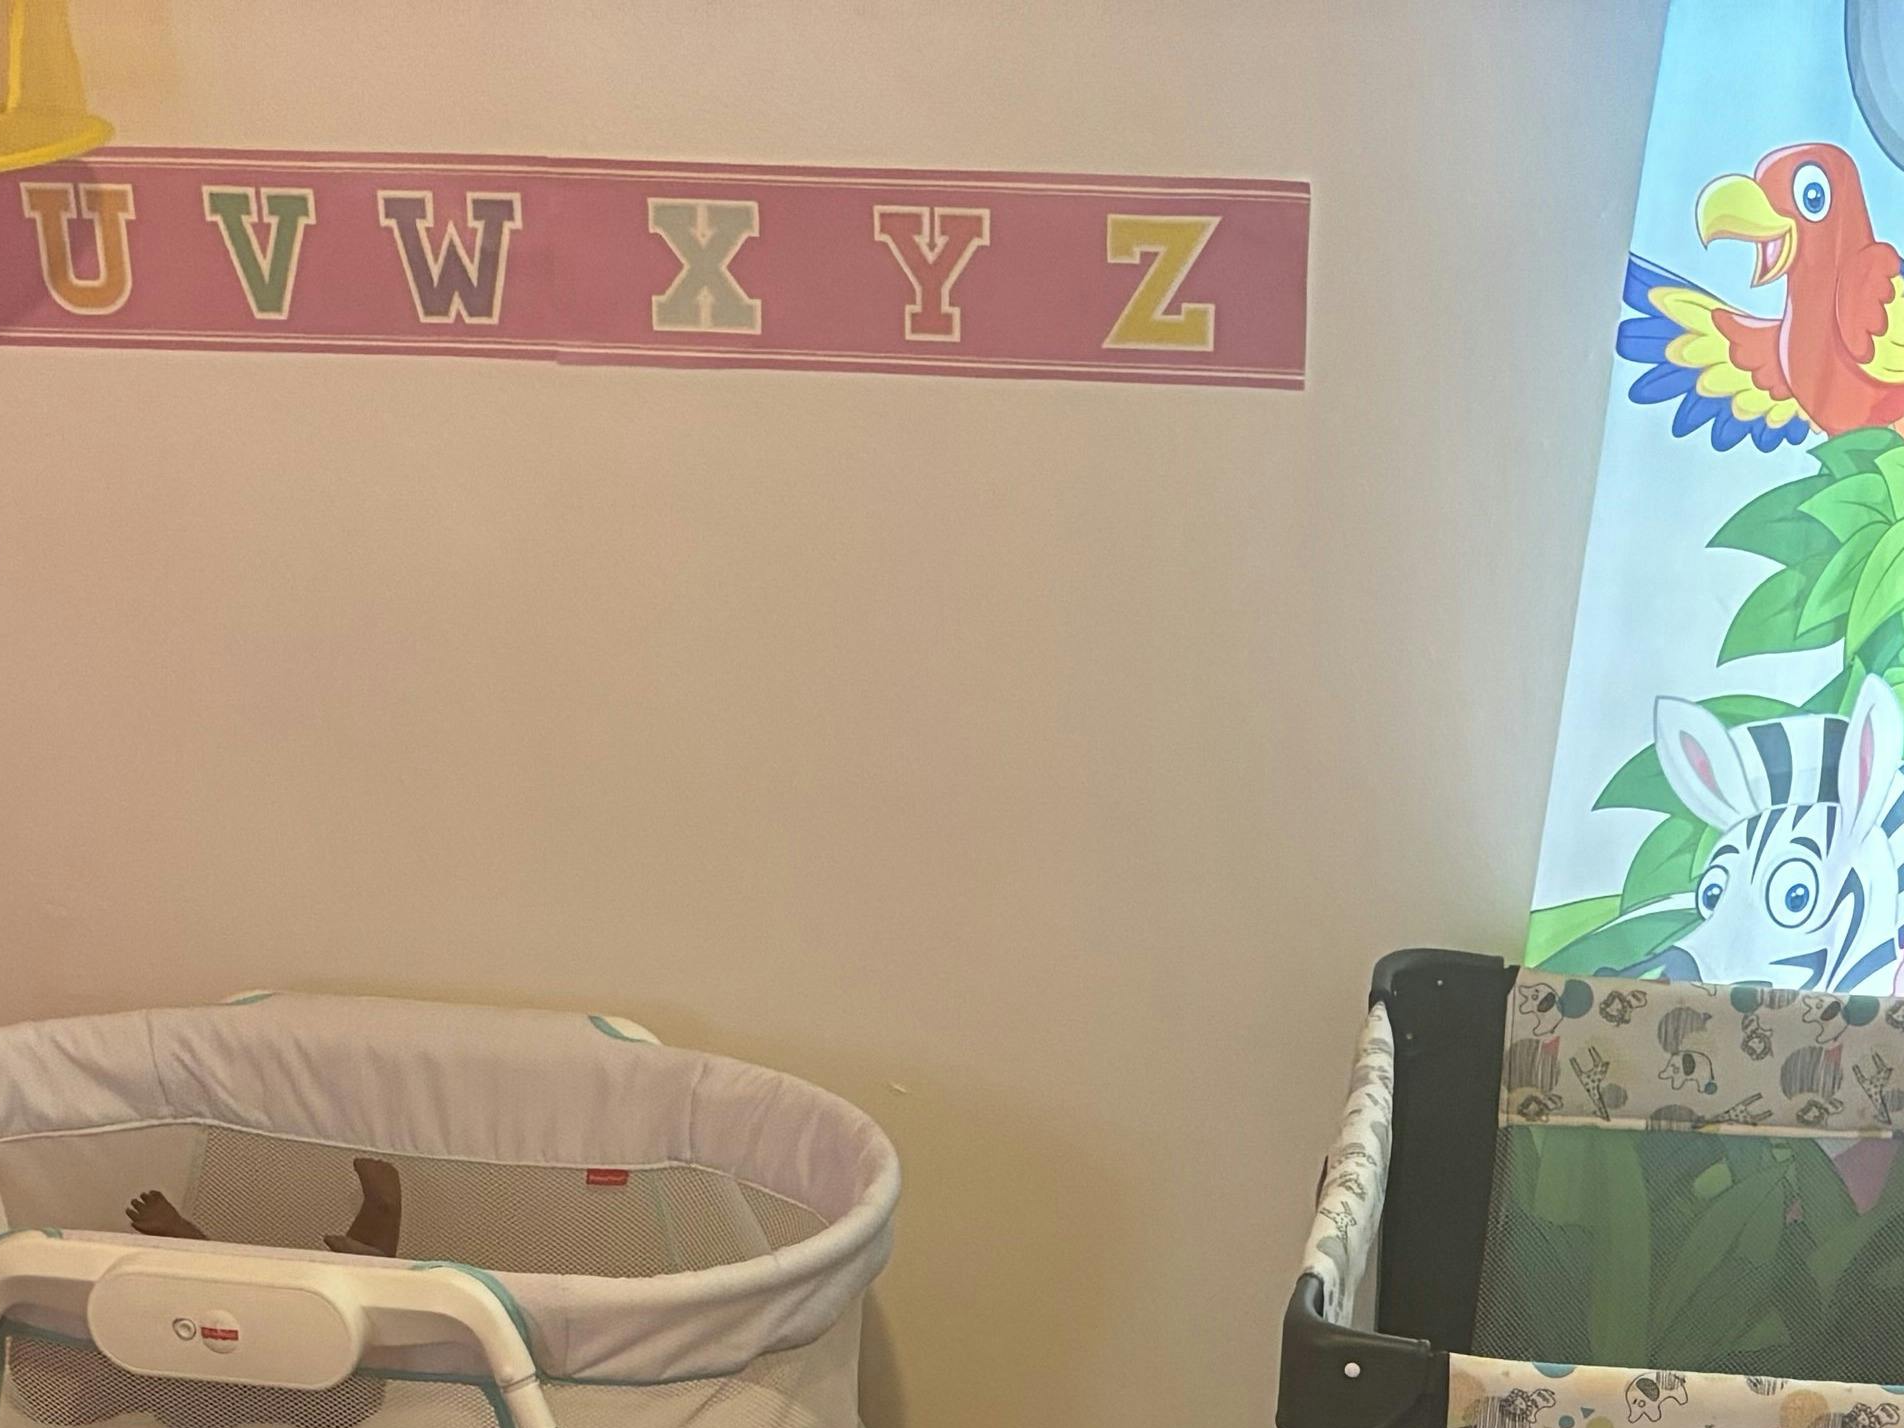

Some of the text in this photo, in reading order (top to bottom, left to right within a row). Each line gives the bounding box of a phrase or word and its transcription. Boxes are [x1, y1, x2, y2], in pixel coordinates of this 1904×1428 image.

[20, 182, 135, 315] U
[202, 185, 316, 320] V
[377, 190, 523, 325] W
[648, 197, 762, 334] X
[872, 205, 991, 342] Y
[1102, 214, 1221, 350] Z
